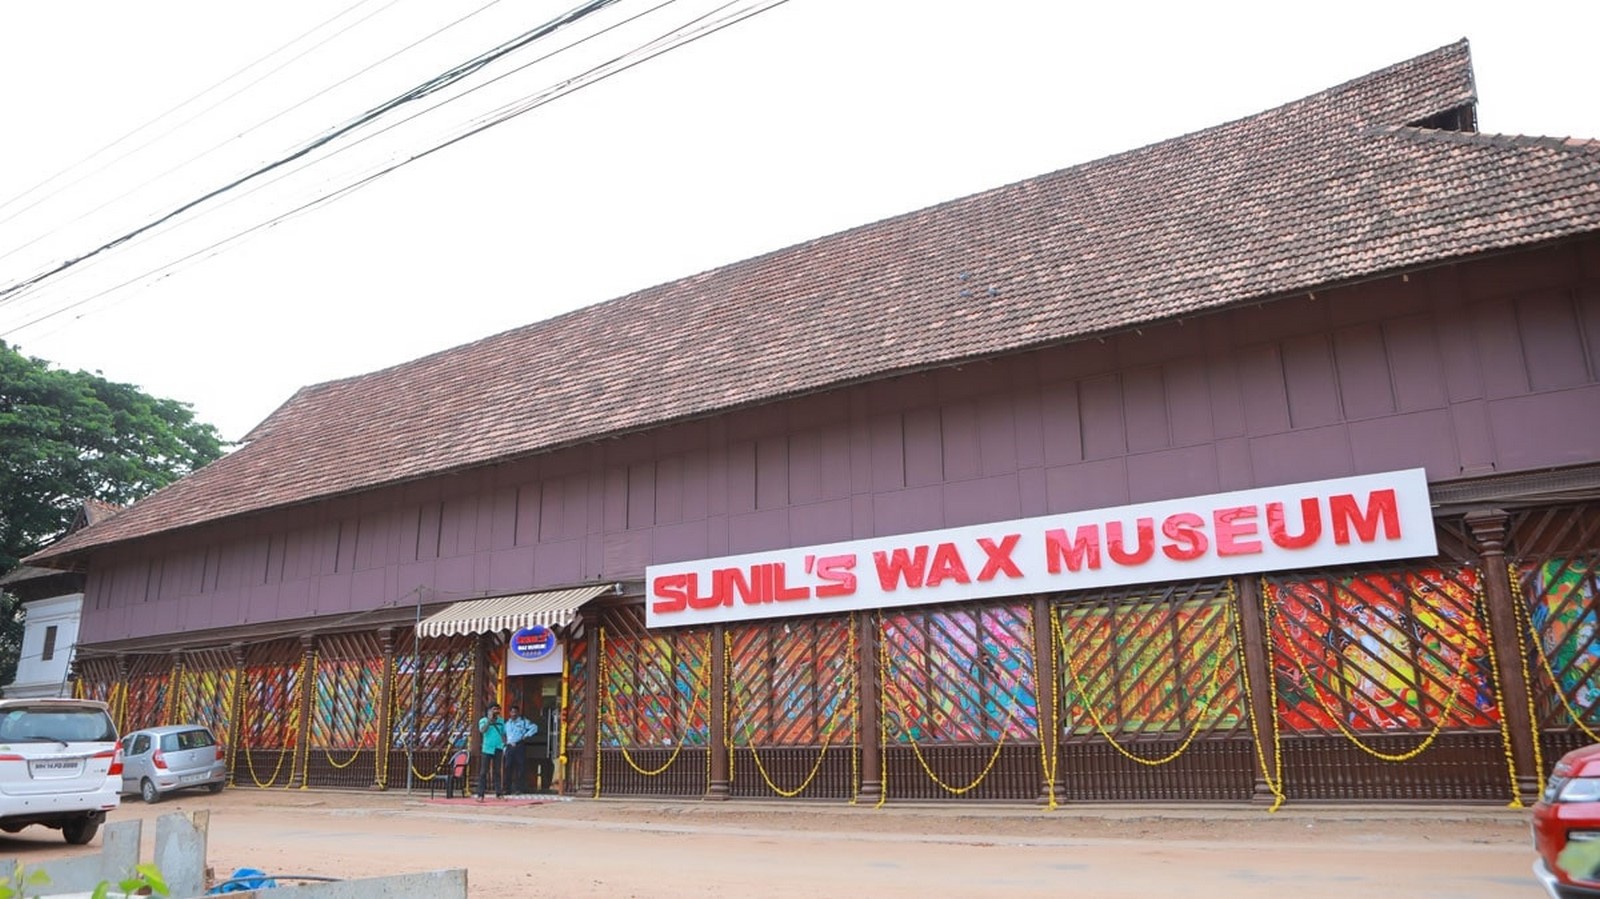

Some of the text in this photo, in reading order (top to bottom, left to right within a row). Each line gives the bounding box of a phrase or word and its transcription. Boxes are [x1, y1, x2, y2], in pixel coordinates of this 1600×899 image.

[652, 488, 1403, 614] SUNIL'S WAX MUSEUM
